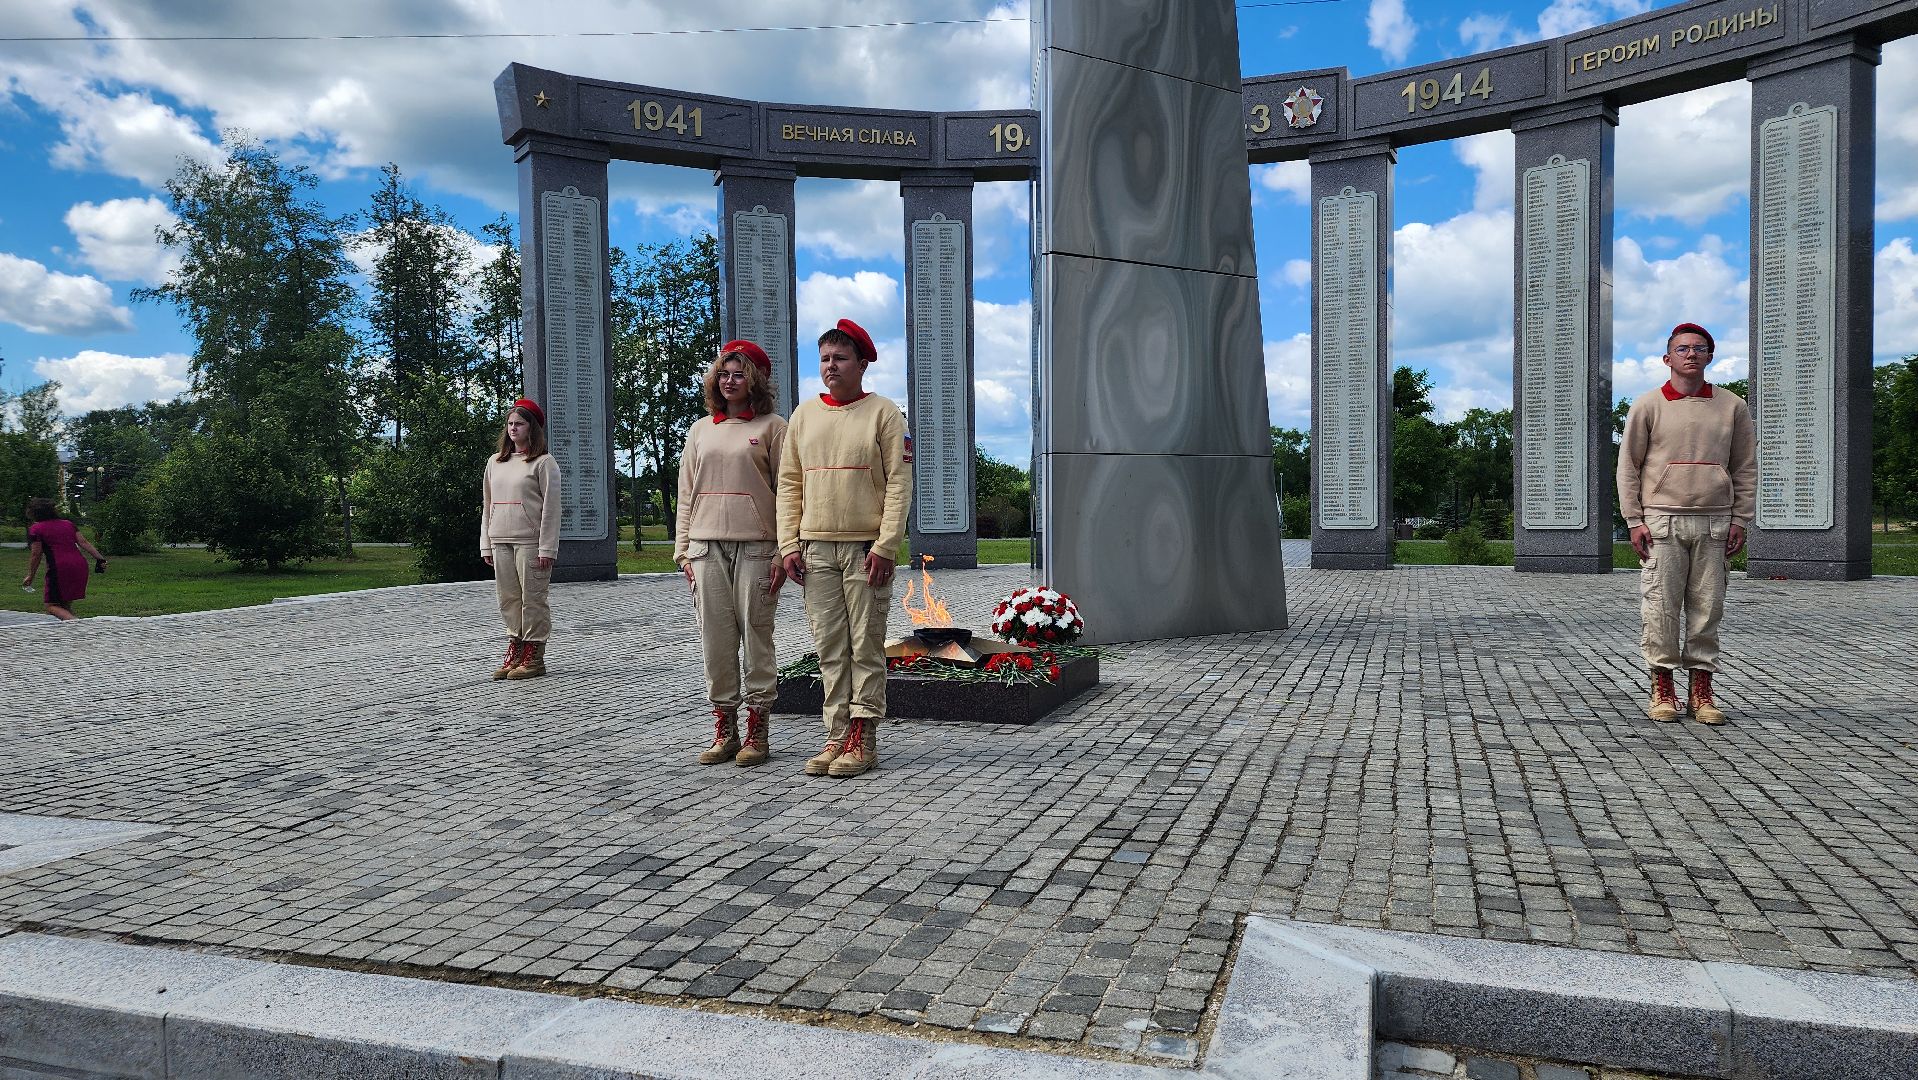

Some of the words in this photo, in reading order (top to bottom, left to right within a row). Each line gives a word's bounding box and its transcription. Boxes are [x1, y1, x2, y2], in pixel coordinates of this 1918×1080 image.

[1570, 35, 1660, 74] ГЕРОЯМ
[1671, 4, 1778, 48] РОДИНЫ
[1401, 67, 1494, 113] 1944
[627, 100, 702, 137] 1941
[1245, 103, 1271, 133] 3
[782, 124, 854, 142] ВЕЧНАЯ
[858, 129, 917, 146] СЛАВА
[989, 123, 1031, 152] 19
